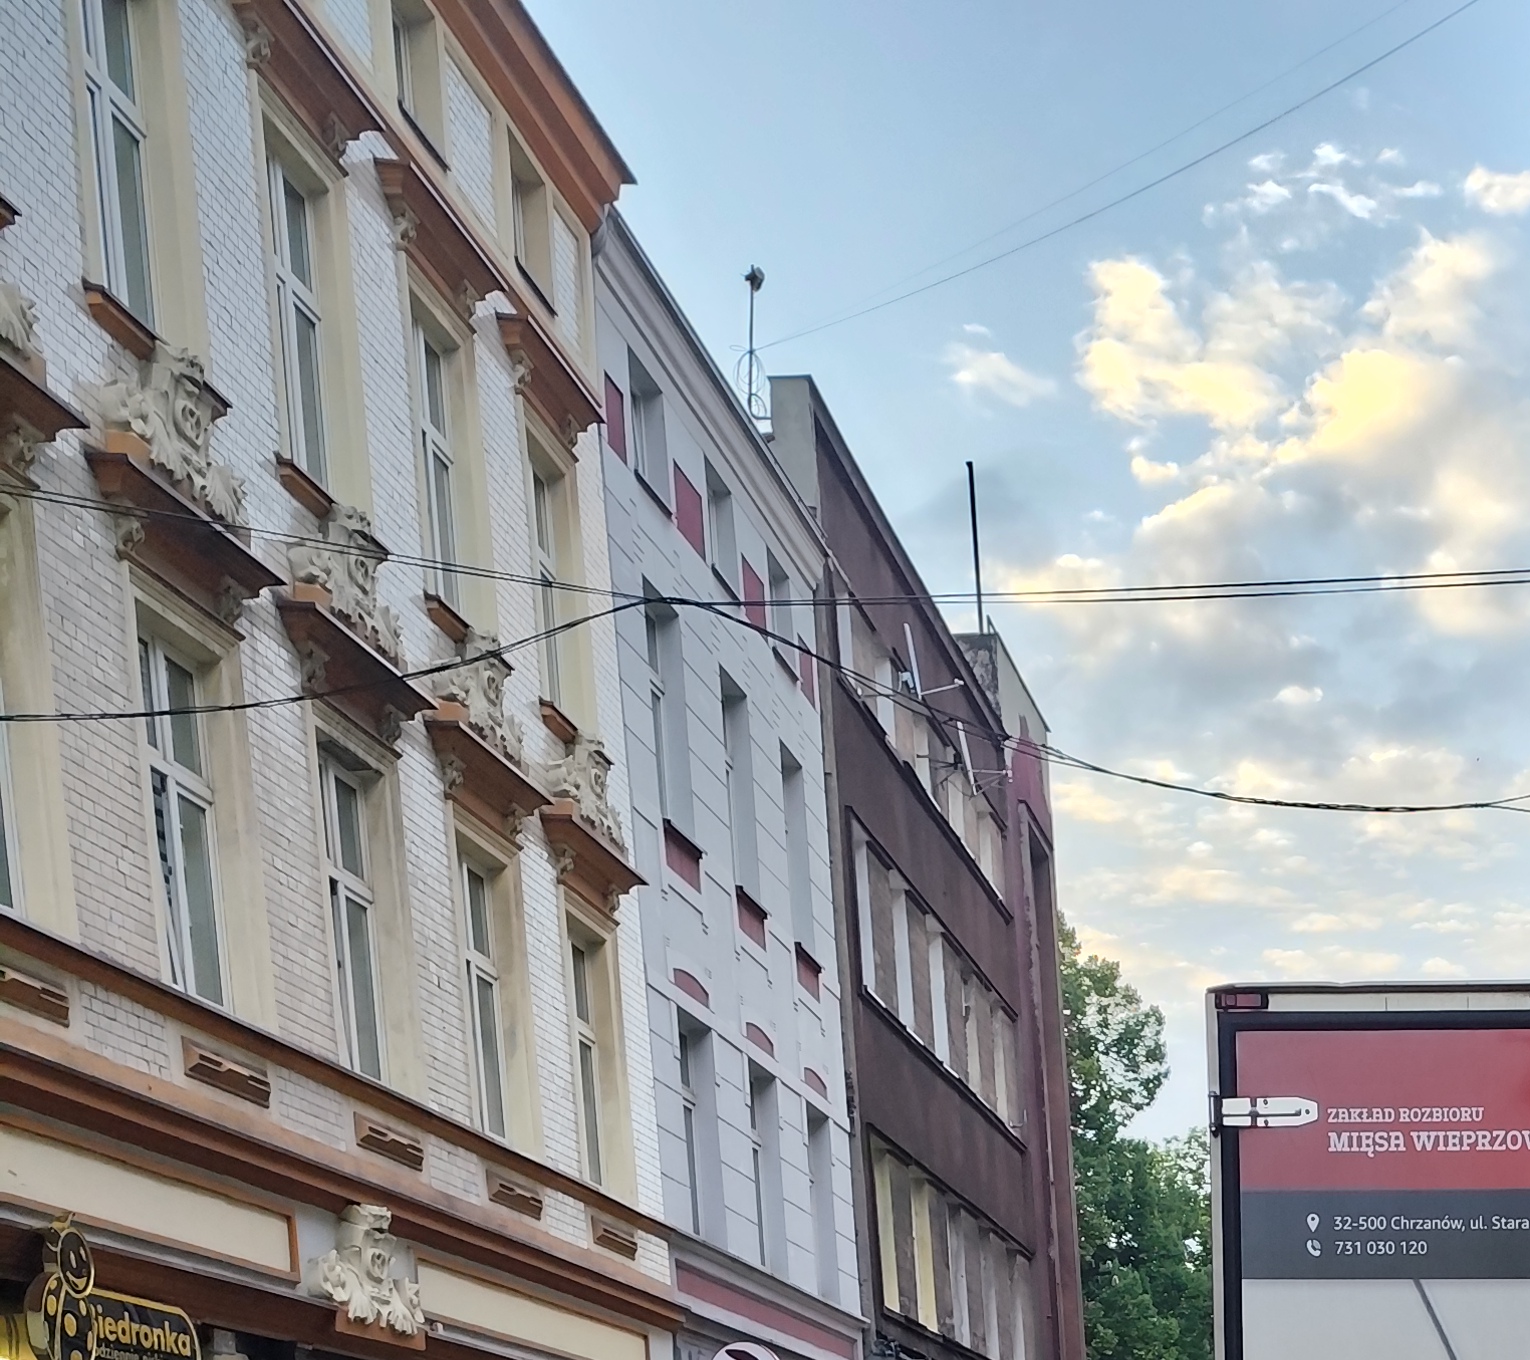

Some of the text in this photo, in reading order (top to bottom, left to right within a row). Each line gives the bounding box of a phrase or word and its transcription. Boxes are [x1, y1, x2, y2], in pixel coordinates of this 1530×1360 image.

[1327, 1106, 1484, 1123] ZAKŁAD ROZBIORU
[1328, 1131, 1406, 1158] MIĘSA
[1333, 1216, 1386, 1231] 32-500
[1390, 1214, 1466, 1232] Chrzanów,
[1470, 1214, 1488, 1230] ul.
[1491, 1215, 1530, 1230] Stara
[1335, 1241, 1428, 1255] 731 030 120
